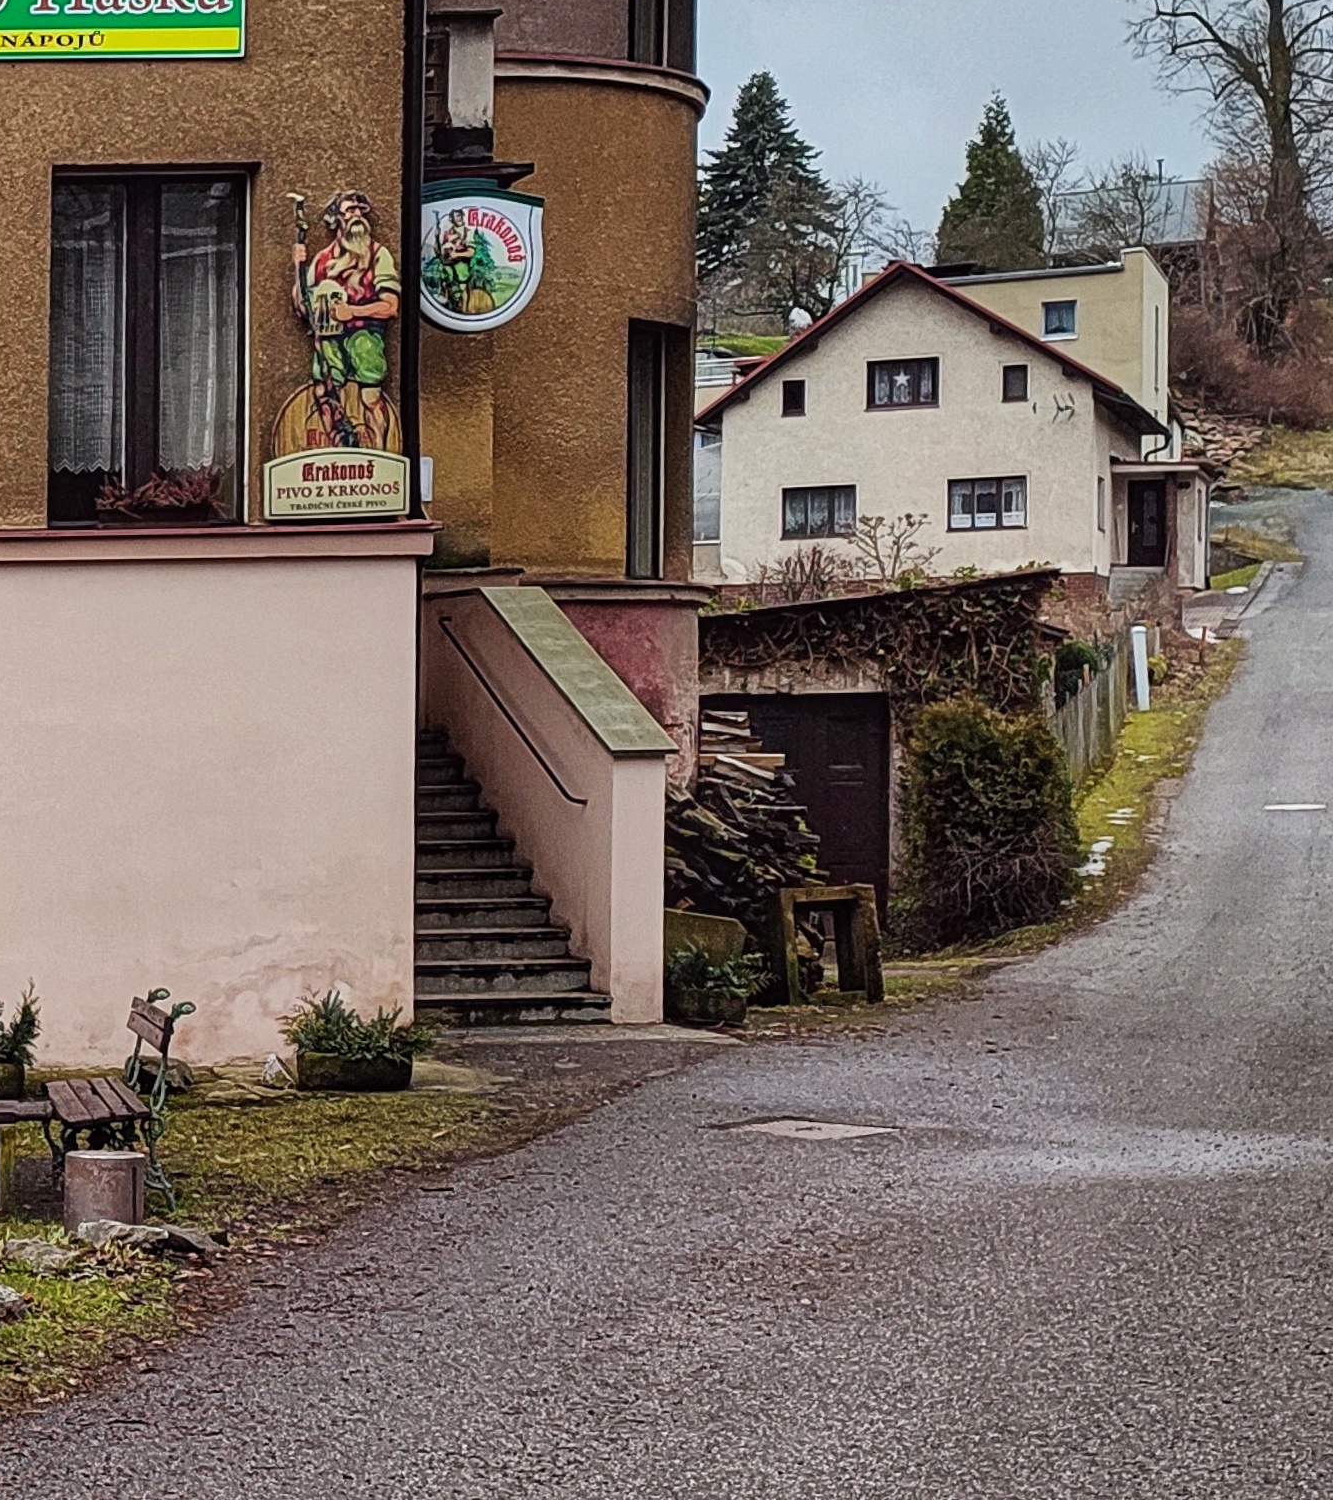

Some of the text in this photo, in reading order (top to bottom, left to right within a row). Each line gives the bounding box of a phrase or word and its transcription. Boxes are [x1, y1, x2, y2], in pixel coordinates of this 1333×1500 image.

[0, 31, 106, 50] NÁPOJŮ
[467, 208, 526, 263] Krakonoš
[301, 460, 375, 482] Krakonoš
[276, 481, 400, 499] PIVO Z KRKONOŠ
[290, 500, 388, 511] TRADIČNÍ ČESKÉ PIVO
